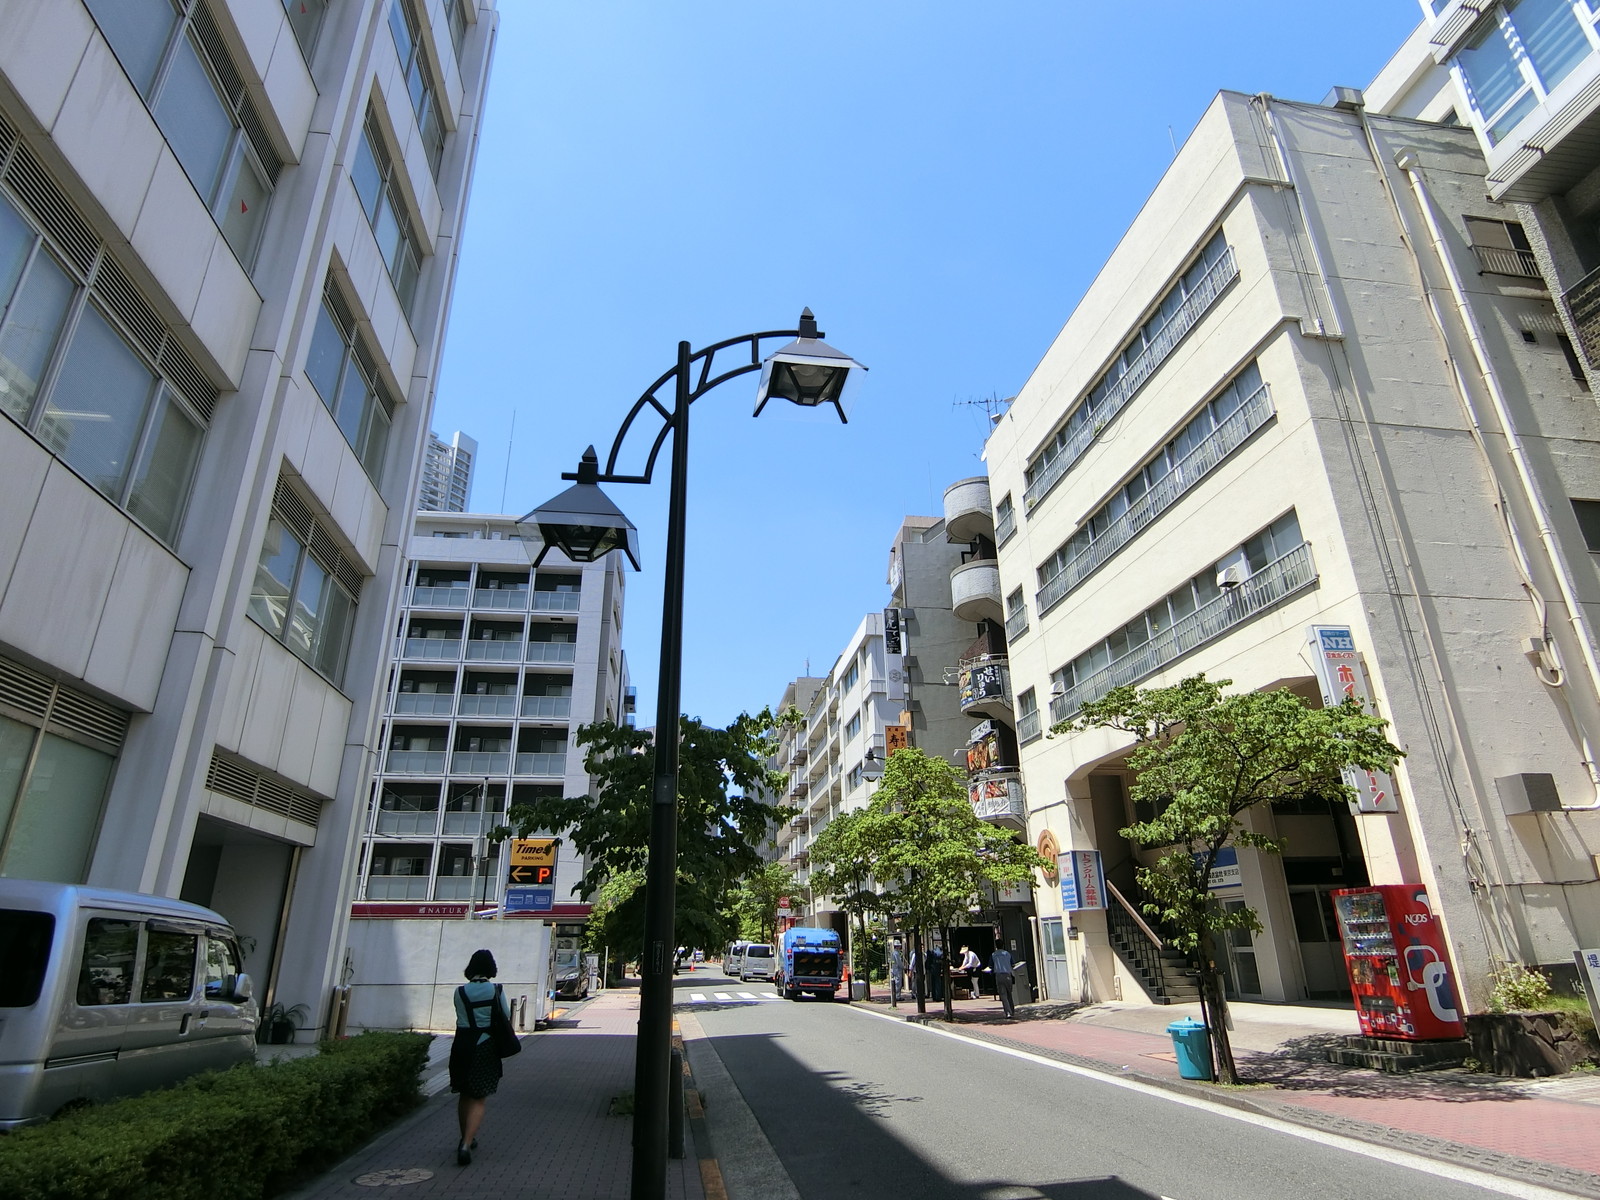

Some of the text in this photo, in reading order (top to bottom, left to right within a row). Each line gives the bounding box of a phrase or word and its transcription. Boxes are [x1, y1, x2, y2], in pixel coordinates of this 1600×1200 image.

[1322, 637, 1353, 649] NH
[516, 844, 551, 855] Time
[538, 867, 550, 883] P
[1082, 853, 1097, 906] トランクルーム募集中
